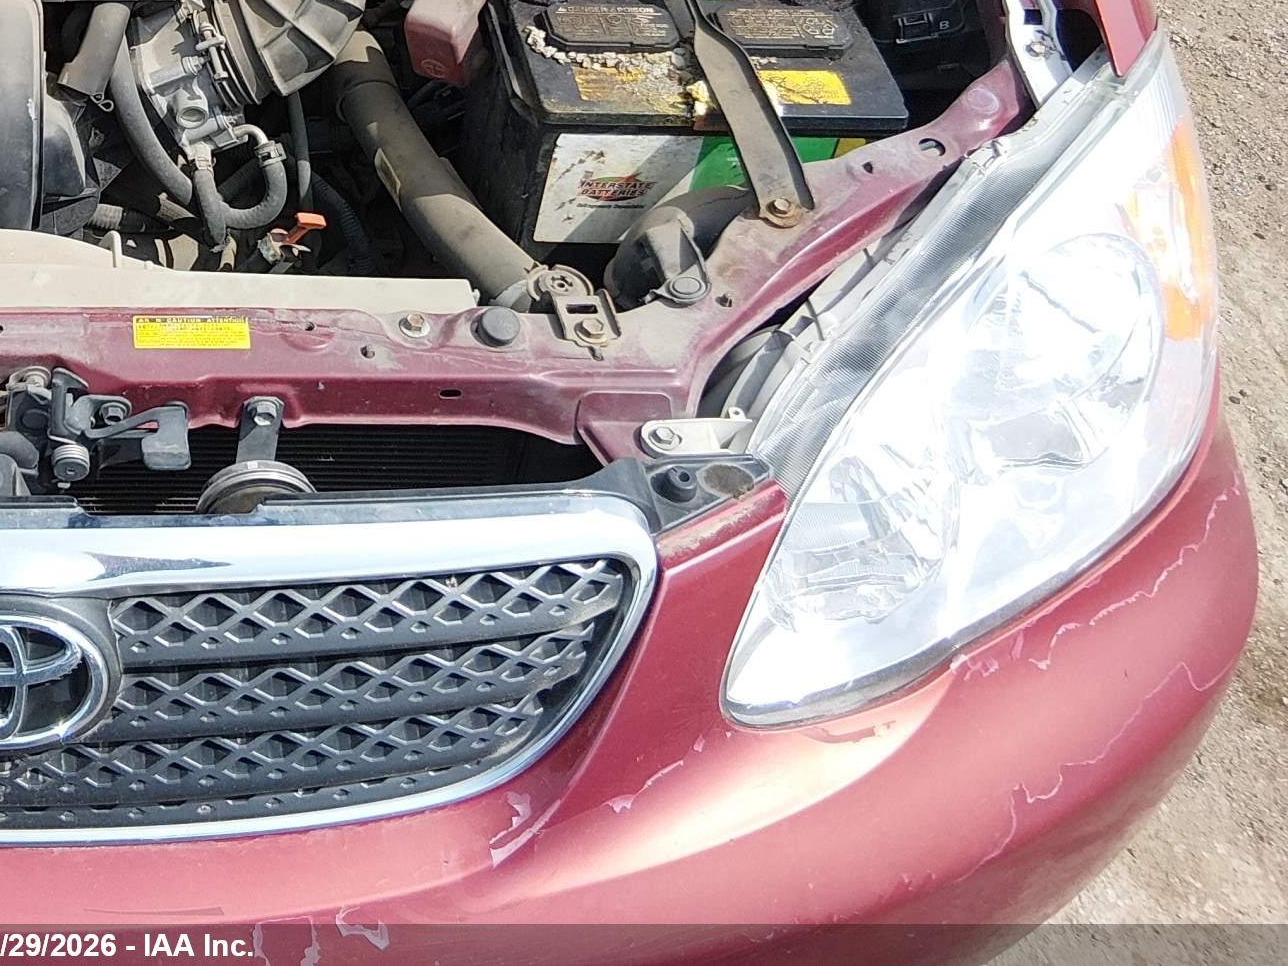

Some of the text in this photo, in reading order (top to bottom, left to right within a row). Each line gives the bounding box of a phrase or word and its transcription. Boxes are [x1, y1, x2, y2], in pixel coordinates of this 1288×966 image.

[939, 20, 950, 30] B
[579, 180, 654, 190] INTERSTATE
[581, 188, 648, 196] BATTERIES
